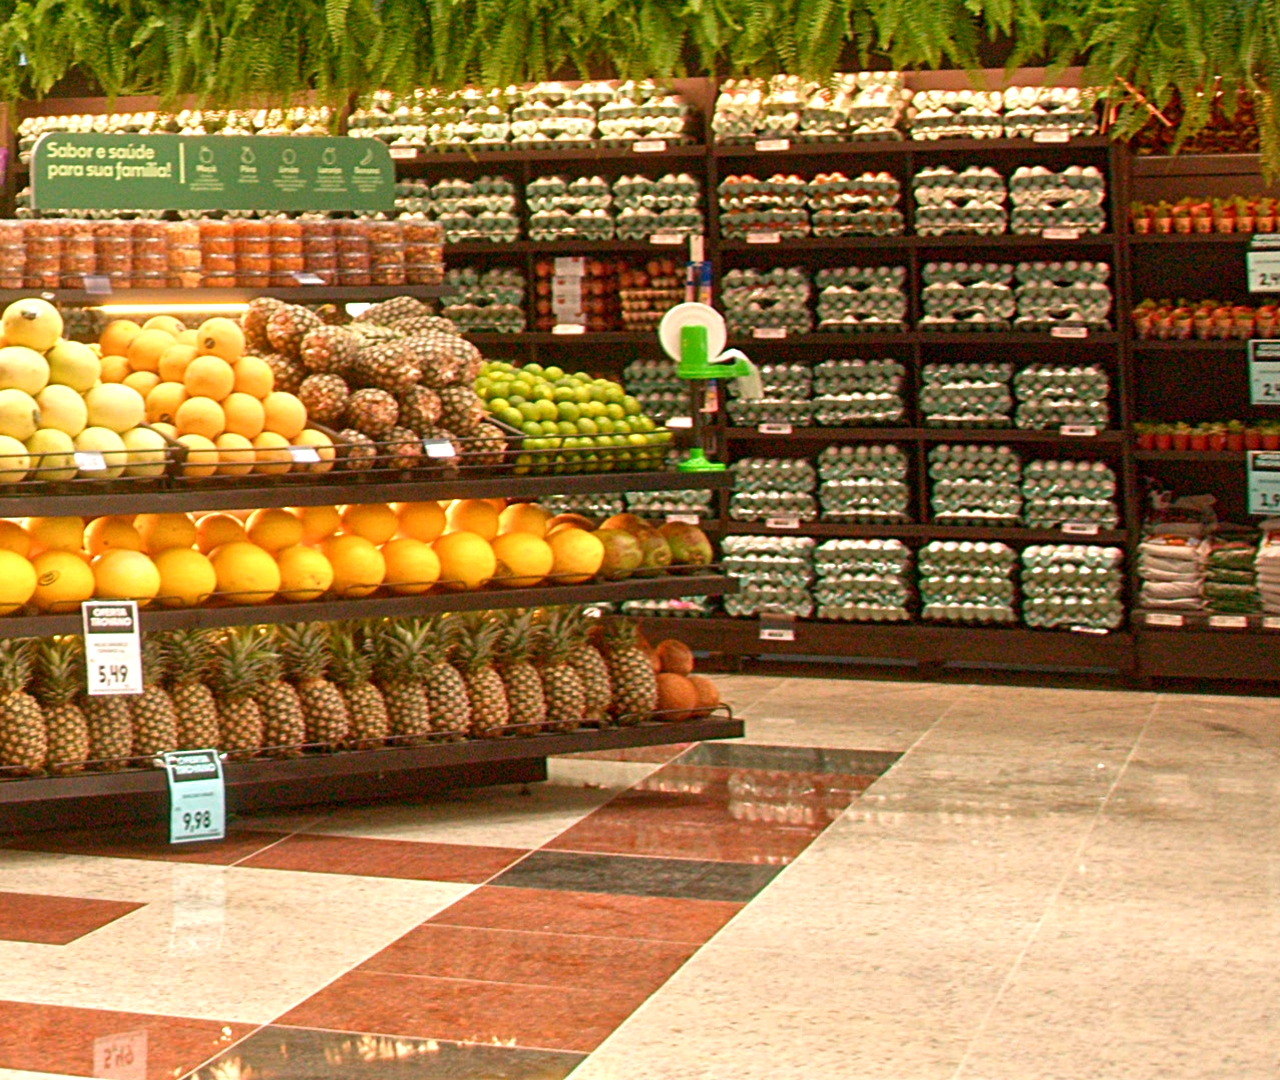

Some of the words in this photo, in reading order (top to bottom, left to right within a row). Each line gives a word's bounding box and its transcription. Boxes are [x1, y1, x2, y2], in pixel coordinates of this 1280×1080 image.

[46, 141, 94, 159] Sabor
[96, 147, 106, 159] e
[108, 143, 155, 159] saúde
[47, 164, 84, 179] para
[86, 165, 113, 177] sua
[98, 664, 128, 686] 5,49
[183, 810, 211, 832] 9,98
